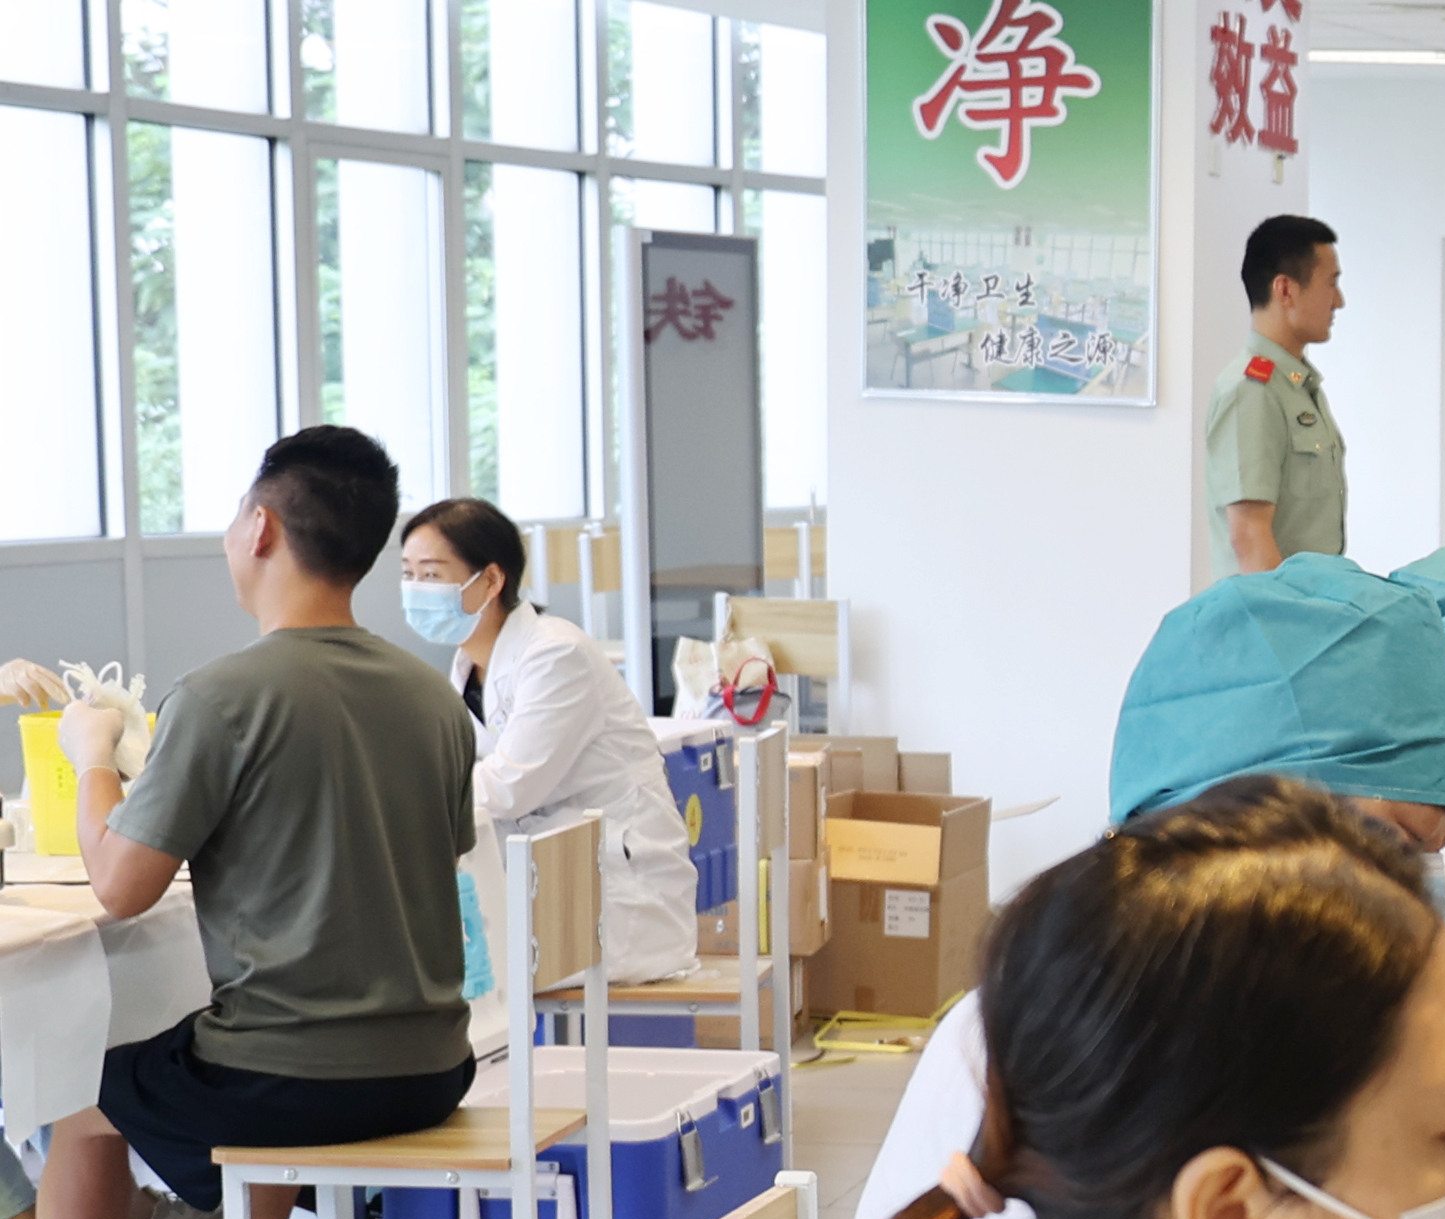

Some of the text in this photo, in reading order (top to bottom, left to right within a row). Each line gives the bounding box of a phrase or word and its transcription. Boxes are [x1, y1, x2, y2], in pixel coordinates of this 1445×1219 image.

[914, 0, 1100, 186] 净
[906, 270, 1037, 309] 干净卫生
[979, 325, 1116, 368] 健康之源
